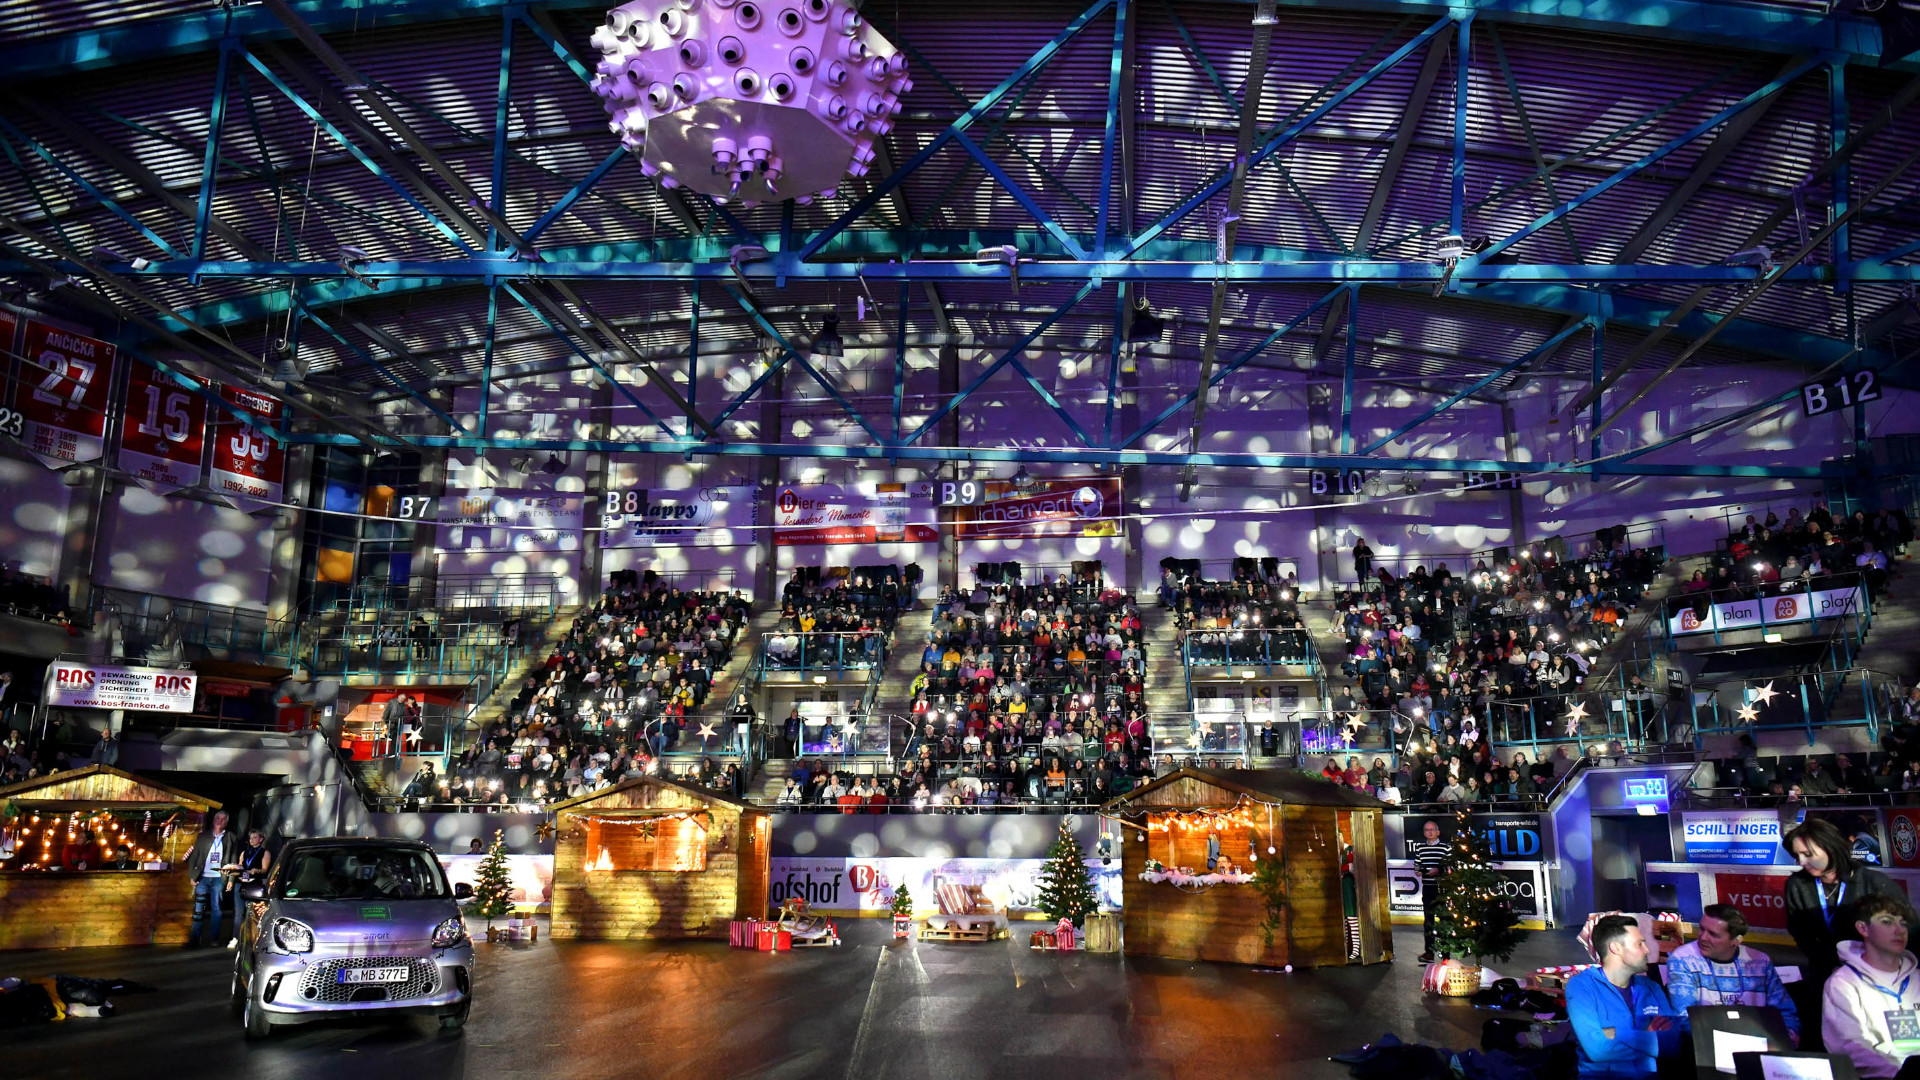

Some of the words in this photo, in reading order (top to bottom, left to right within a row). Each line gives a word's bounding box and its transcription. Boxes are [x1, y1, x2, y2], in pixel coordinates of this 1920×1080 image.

[32, 350, 97, 411] 27
[138, 385, 190, 443] 15
[230, 415, 270, 462] 35
[783, 513, 823, 526] besondere
[827, 509, 871, 522] Momente
[982, 497, 1067, 521] charivari
[634, 521, 684, 536] Time
[1821, 594, 1853, 612] plan
[1723, 606, 1752, 623] plan
[101, 672, 153, 681] BEWACHUNG
[74, 698, 170, 710] www.bos-franken.de
[1687, 824, 1778, 836] SCHILLINGER
[770, 874, 842, 903] ofshof
[344, 972, 354, 981] R
[360, 970, 376, 980] MB
[378, 968, 407, 980] 377E
